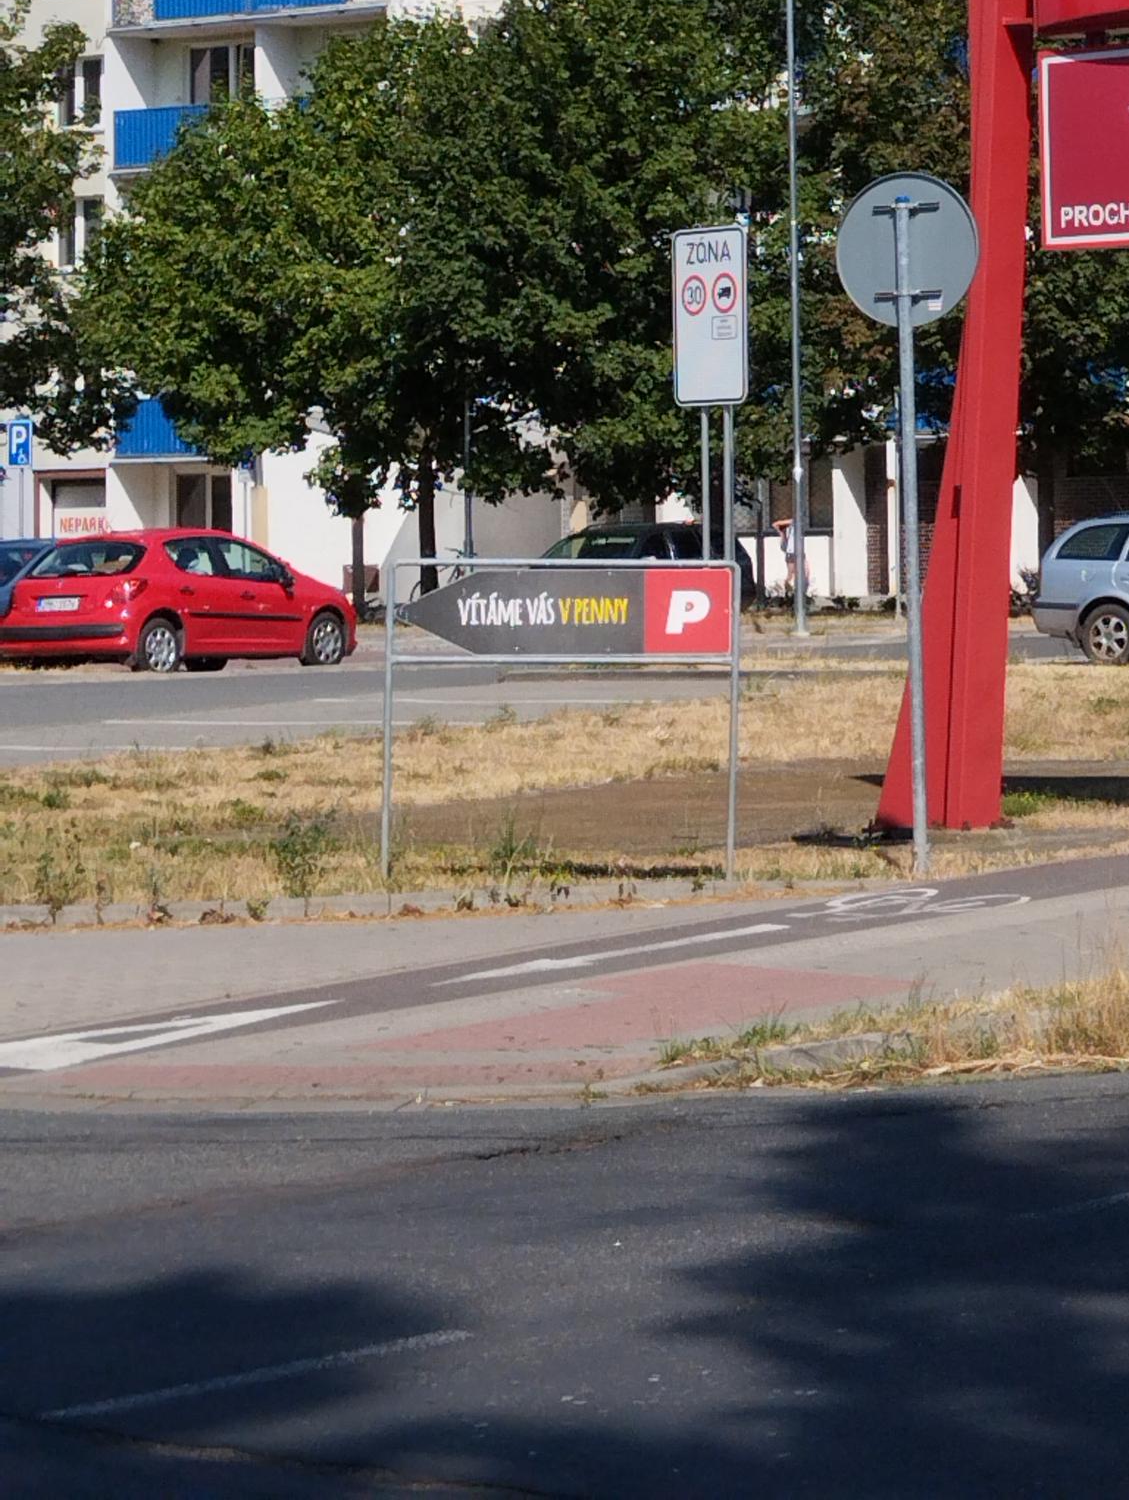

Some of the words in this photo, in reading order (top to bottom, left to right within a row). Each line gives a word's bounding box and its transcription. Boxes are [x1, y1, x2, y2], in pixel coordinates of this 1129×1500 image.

[686, 286, 702, 305] 30
[11, 426, 27, 454] P
[457, 592, 523, 626] VÍTÁME
[525, 591, 555, 625] VÁS
[558, 598, 571, 625] V
[574, 598, 628, 625] PENNY
[665, 590, 710, 634] P
